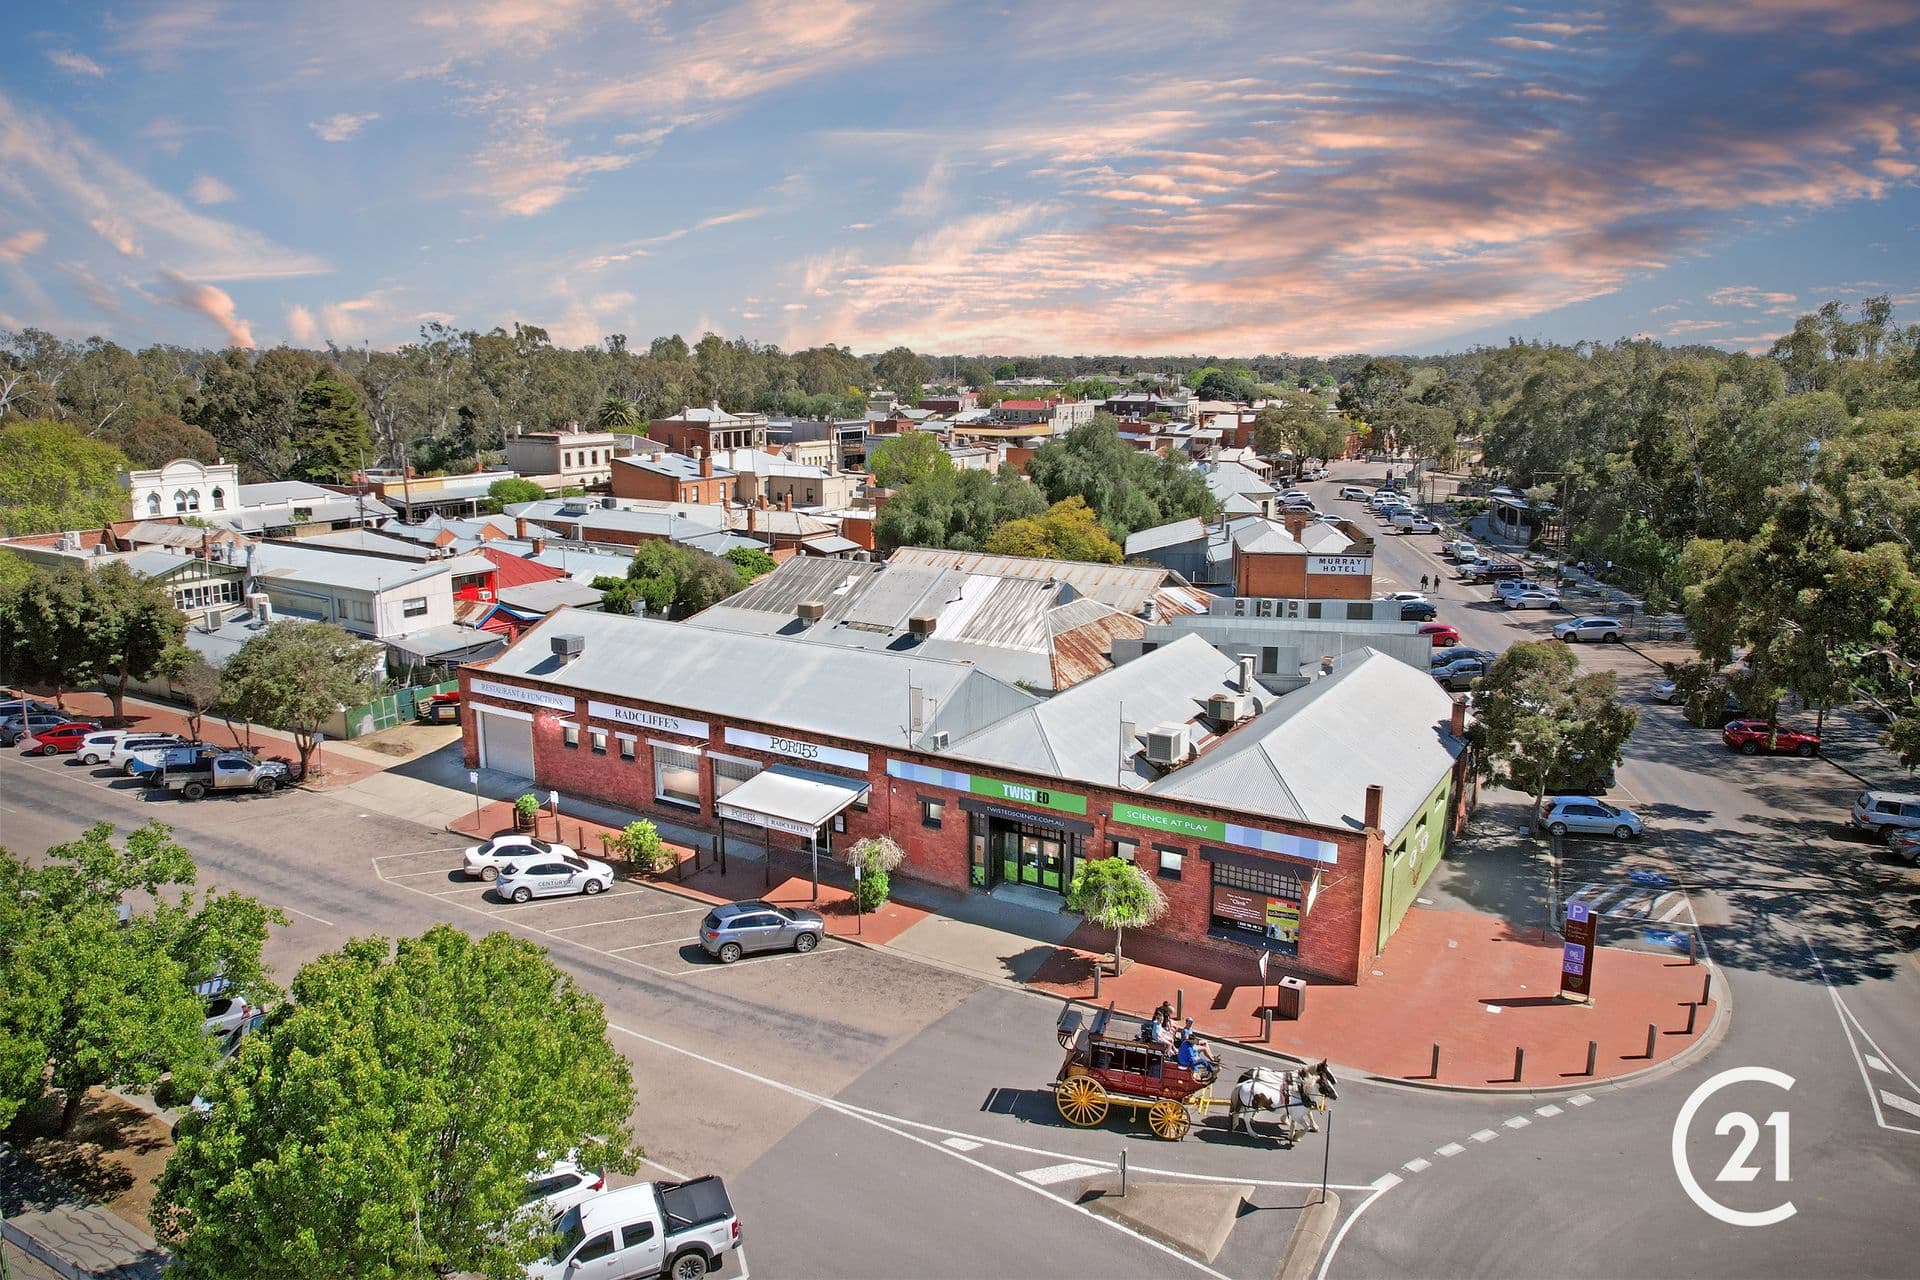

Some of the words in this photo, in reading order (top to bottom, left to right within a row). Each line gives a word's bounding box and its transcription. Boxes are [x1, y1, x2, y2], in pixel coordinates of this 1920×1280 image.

[1318, 557, 1362, 565] MURRAY
[480, 683, 520, 697] RESTAURANT
[527, 692, 564, 706] FUNCTIONS
[614, 708, 679, 730] RADCLIFFE'S
[769, 736, 818, 758] PORT53
[1002, 784, 1050, 804] TWISTED
[986, 806, 1065, 827] TWISTEDSCIENCE.COM.AU
[1126, 810, 1168, 825] SCIENCE
[1170, 819, 1183, 827] AT
[1184, 821, 1208, 832] PLAY
[1572, 904, 1584, 918] P
